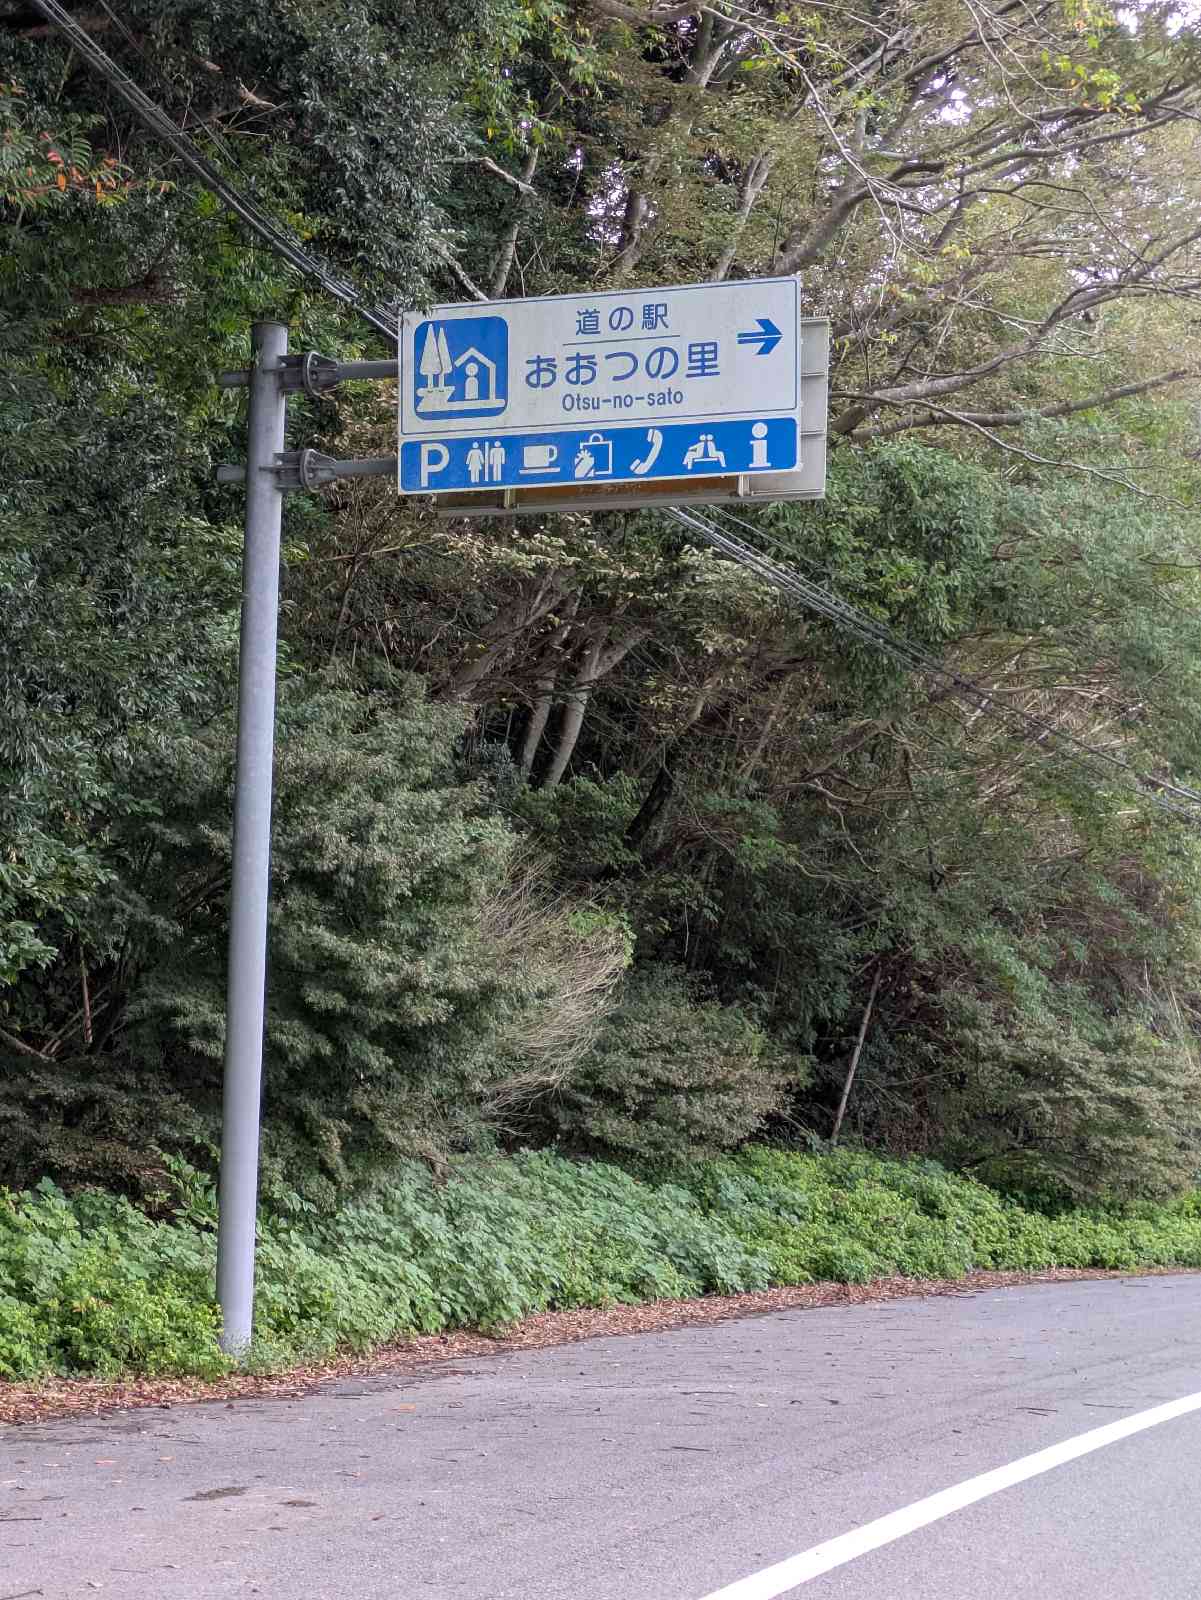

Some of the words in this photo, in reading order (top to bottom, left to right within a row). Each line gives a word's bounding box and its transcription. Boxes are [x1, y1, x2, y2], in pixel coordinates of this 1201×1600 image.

[575, 302, 669, 336] 道の駅
[524, 341, 721, 389] おおつの里
[562, 388, 684, 412] Otsu-no-sato
